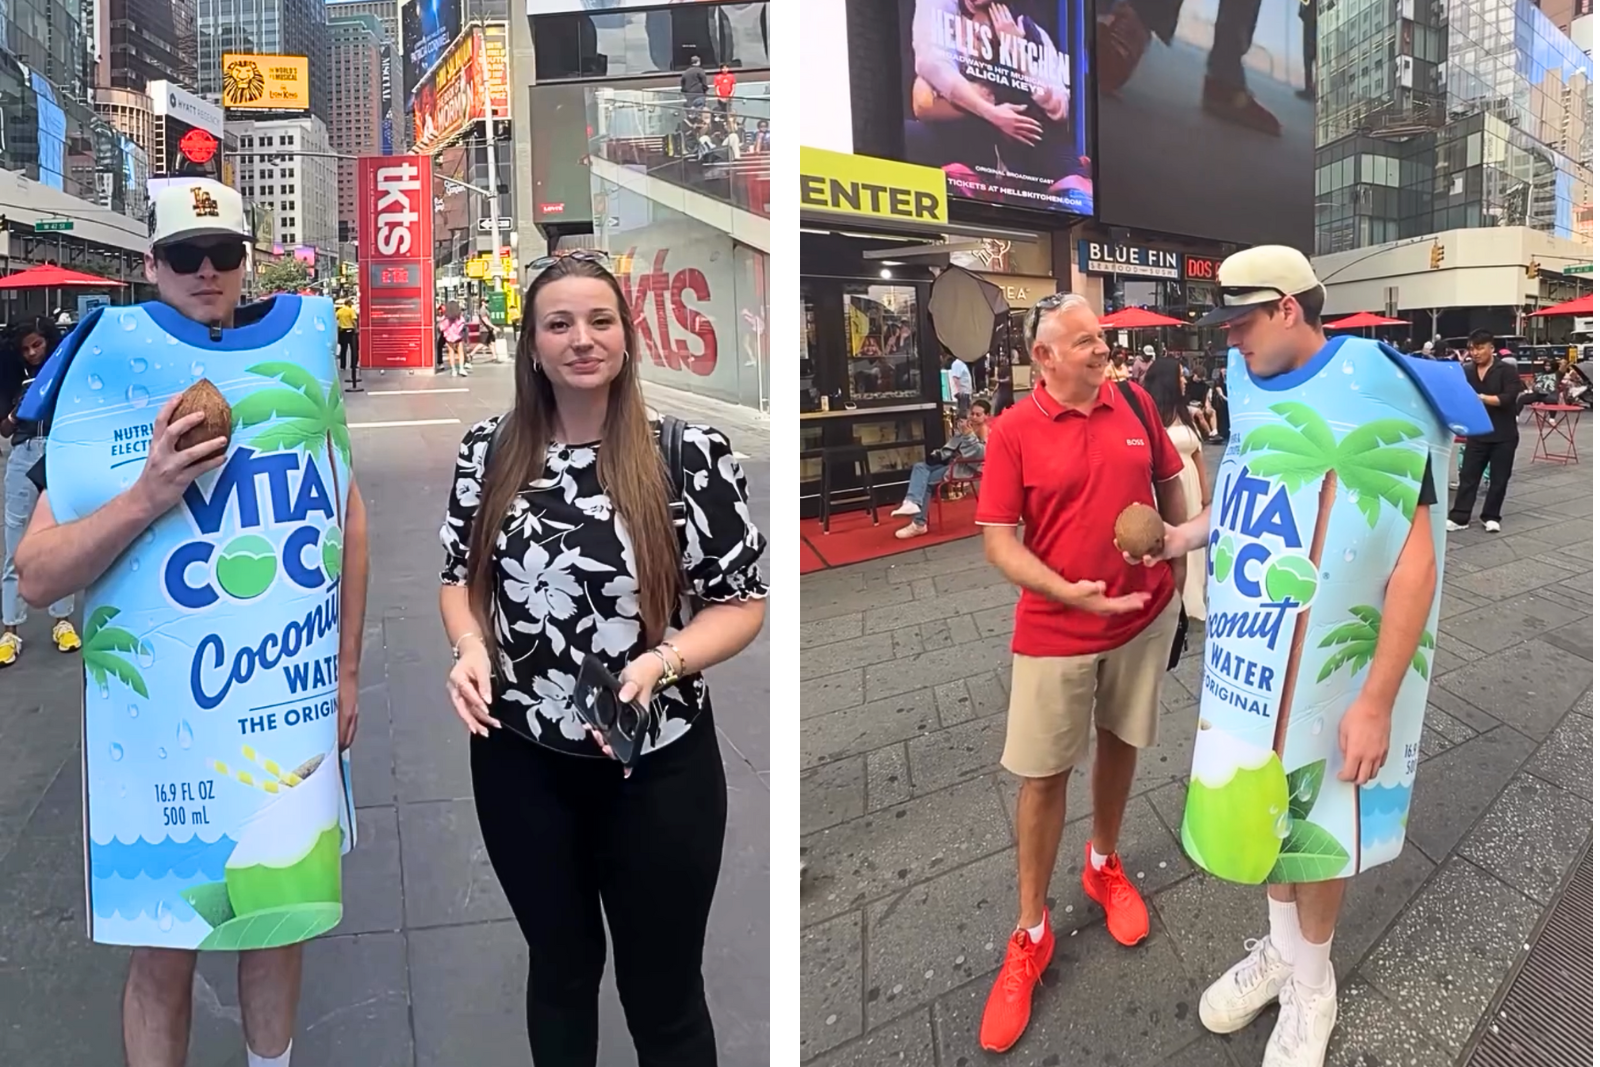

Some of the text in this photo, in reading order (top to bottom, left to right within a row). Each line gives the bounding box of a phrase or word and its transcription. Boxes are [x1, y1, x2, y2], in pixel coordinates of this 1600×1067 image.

[931, 8, 1071, 86] HELL'S KITCHEN
[966, 65, 1045, 95] ALICIA KEYS
[994, 65, 1009, 76] HIT
[1010, 71, 1046, 85] MUSICAL
[178, 100, 196, 115] HYATT
[975, 165, 1054, 185] ORIGINAL BROADWAY CAST
[800, 174, 940, 220] ENTER
[947, 178, 1082, 206] TICKETS AT HELLSKITCHEN.COM
[377, 162, 420, 255] tkts
[1090, 243, 1177, 268] BLUE FIN
[1090, 262, 1177, 277] SEAFOOD SUSHI
[1188, 259, 1212, 278] DOS
[619, 246, 718, 376] kts
[111, 439, 152, 456] ELECT
[1126, 438, 1144, 446] BOSS
[183, 446, 334, 535] VITA
[1220, 465, 1303, 548] VITA
[165, 525, 342, 608] COCO
[1208, 596, 1299, 651] conut
[1211, 642, 1275, 692] WATER
[1205, 674, 1271, 718] ORIGINAL
[238, 713, 277, 735] THE
[155, 780, 215, 802] 16.9 FL OZ
[163, 805, 209, 826] 500 mL
